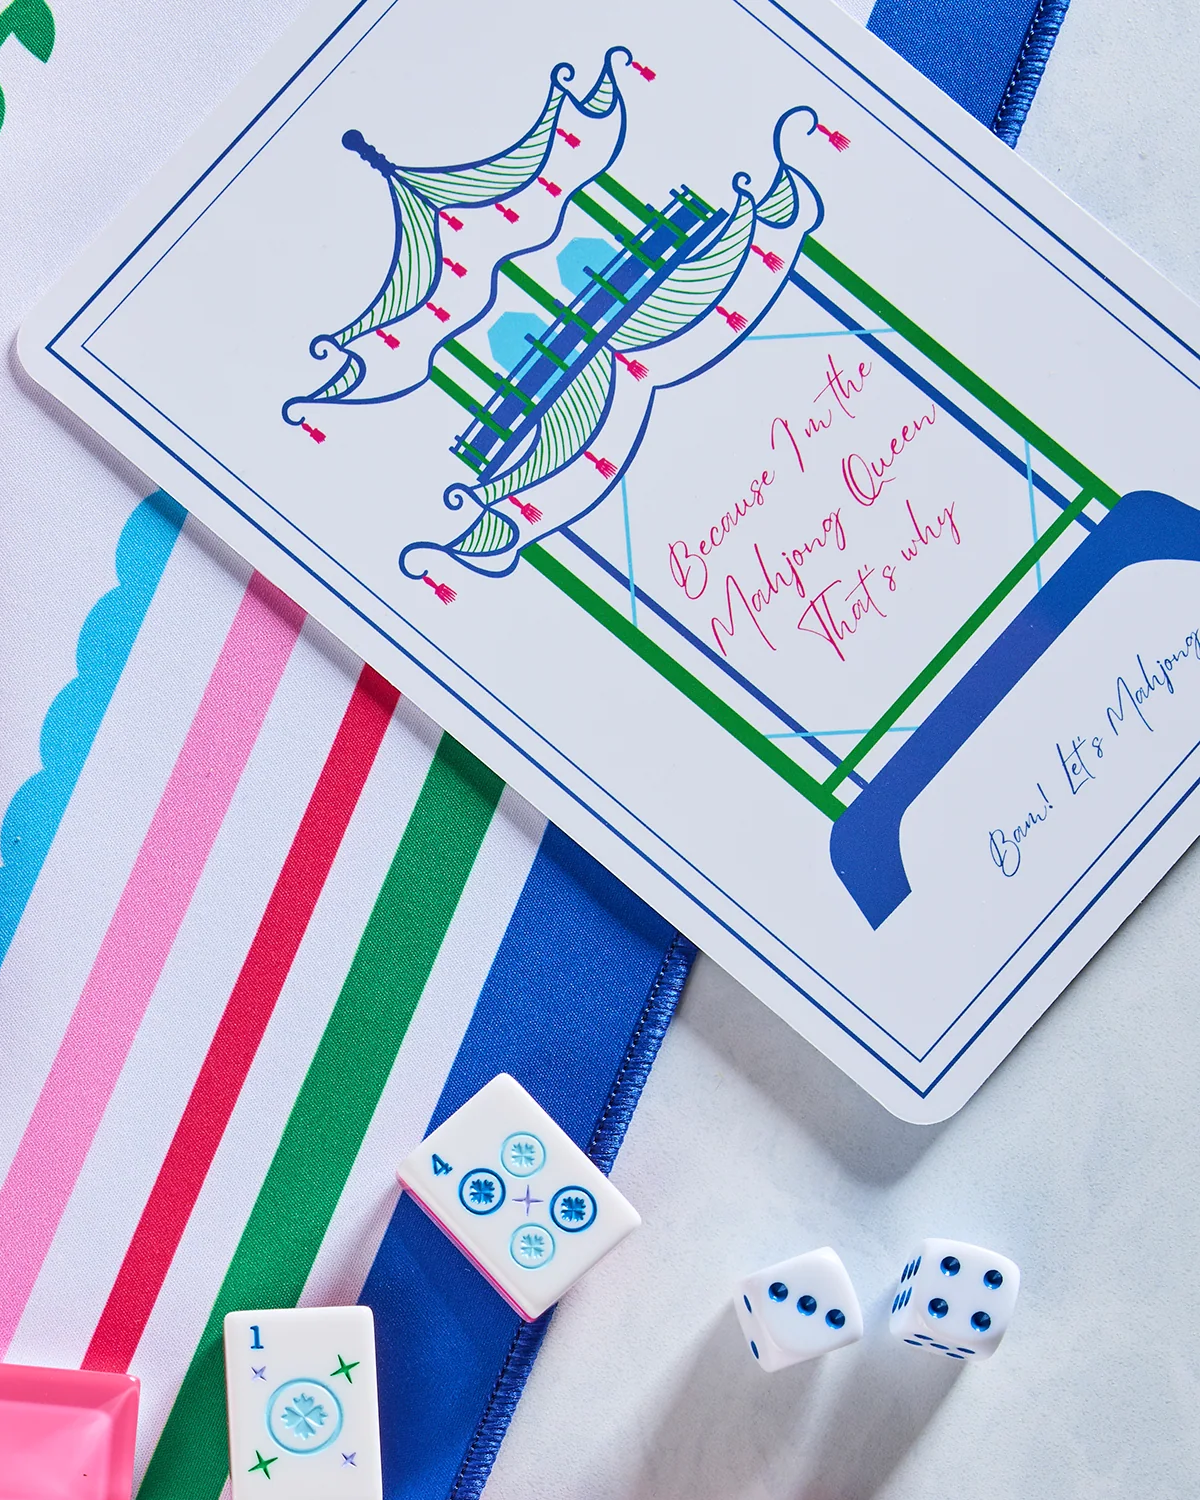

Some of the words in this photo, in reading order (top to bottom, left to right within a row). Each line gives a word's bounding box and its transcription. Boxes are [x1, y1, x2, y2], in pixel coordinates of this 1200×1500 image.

[668, 470, 775, 599] Because
[813, 354, 872, 418] the
[711, 507, 846, 657] Mahjong
[841, 404, 936, 506] Queen
[797, 564, 896, 661] That's
[901, 500, 960, 561] why
[988, 783, 1053, 877] Bam!
[1056, 736, 1104, 795] Let's
[1106, 628, 1200, 733] Mahjong
[430, 1153, 453, 1176] 4
[250, 1326, 264, 1349] 1
